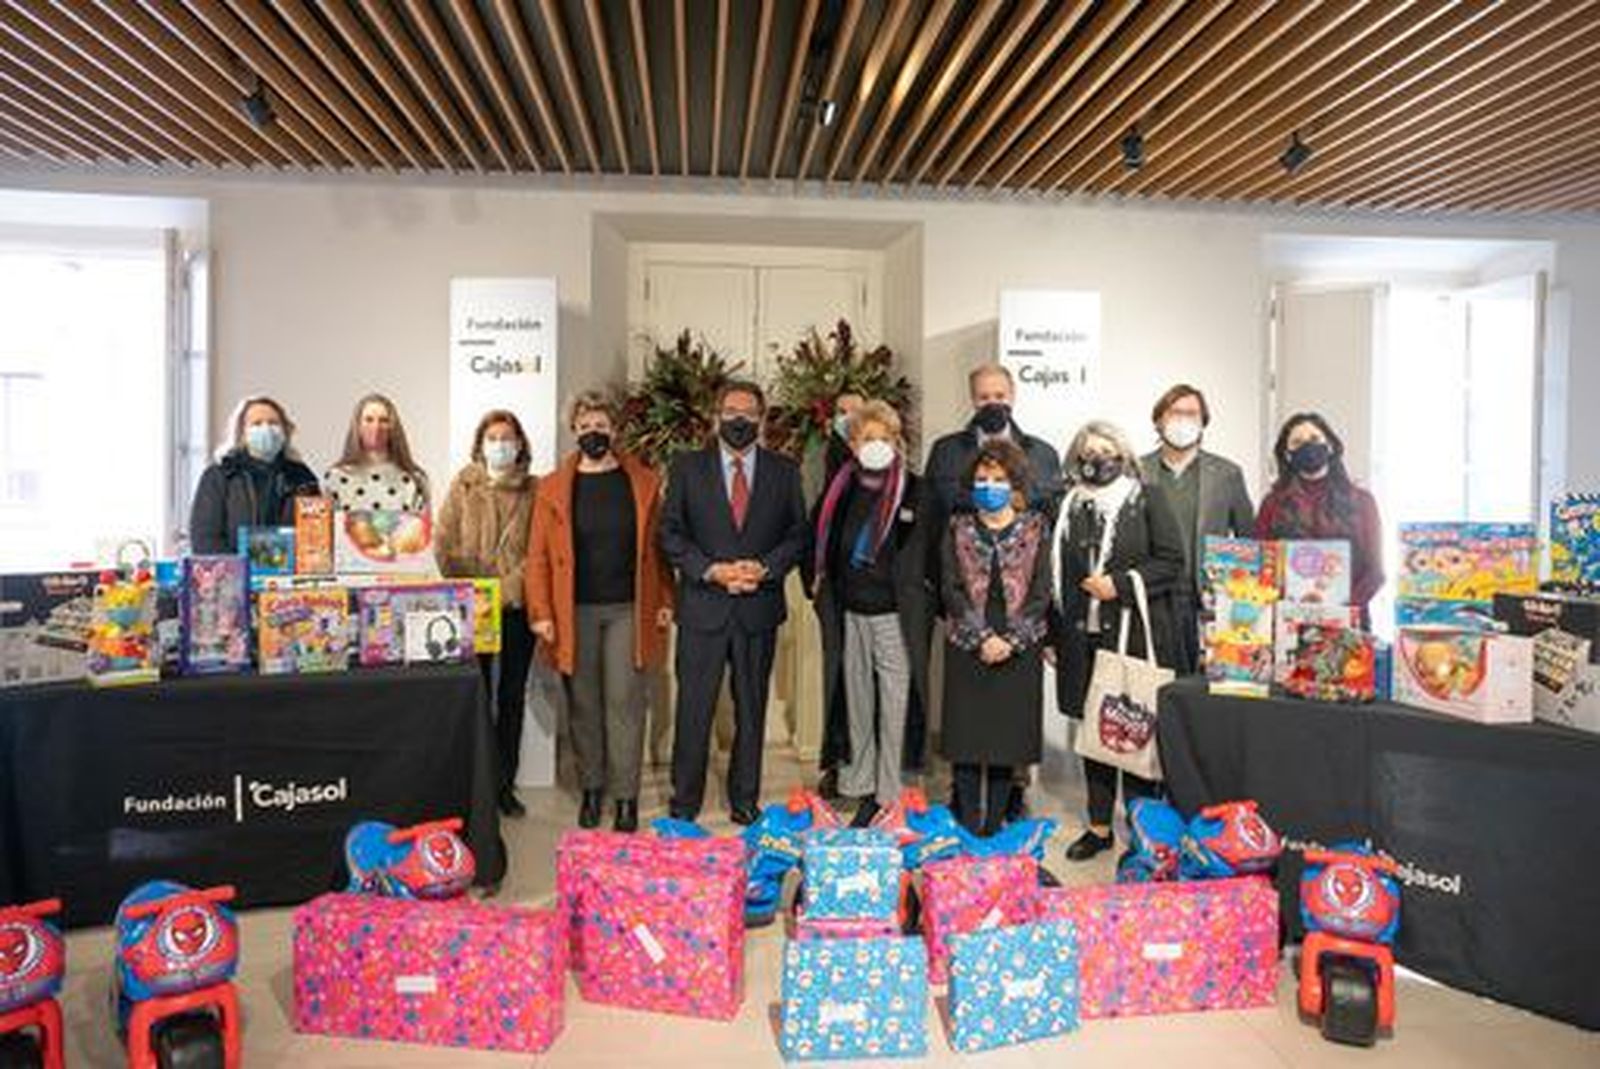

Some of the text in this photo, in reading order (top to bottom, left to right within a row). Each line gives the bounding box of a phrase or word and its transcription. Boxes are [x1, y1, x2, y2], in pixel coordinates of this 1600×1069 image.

[471, 355, 542, 379] Cajasl
[1018, 365, 1086, 389] Cajasl
[123, 777, 348, 814] Fundación Cajasol
[1395, 862, 1462, 894] ajasol
